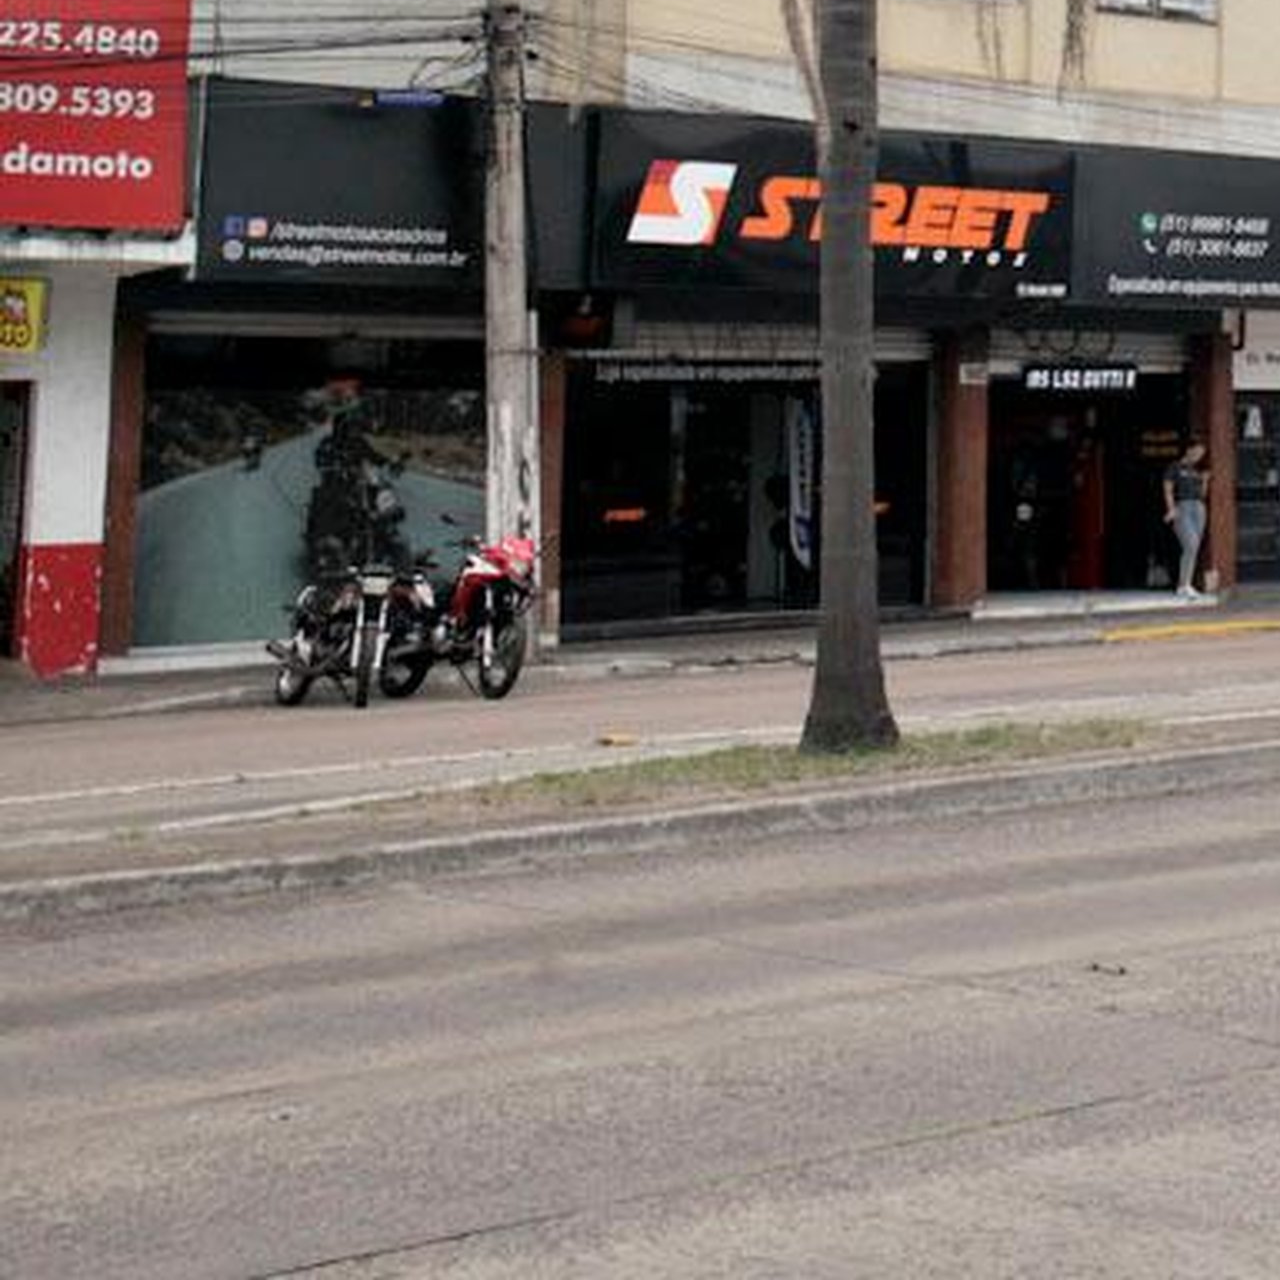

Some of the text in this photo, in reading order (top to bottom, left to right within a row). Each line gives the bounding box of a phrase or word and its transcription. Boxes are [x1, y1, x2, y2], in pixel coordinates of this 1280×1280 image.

[3, 142, 152, 178] damoto
[740, 176, 1050, 250] STREET
[903, 249, 1029, 267] MOTOS
